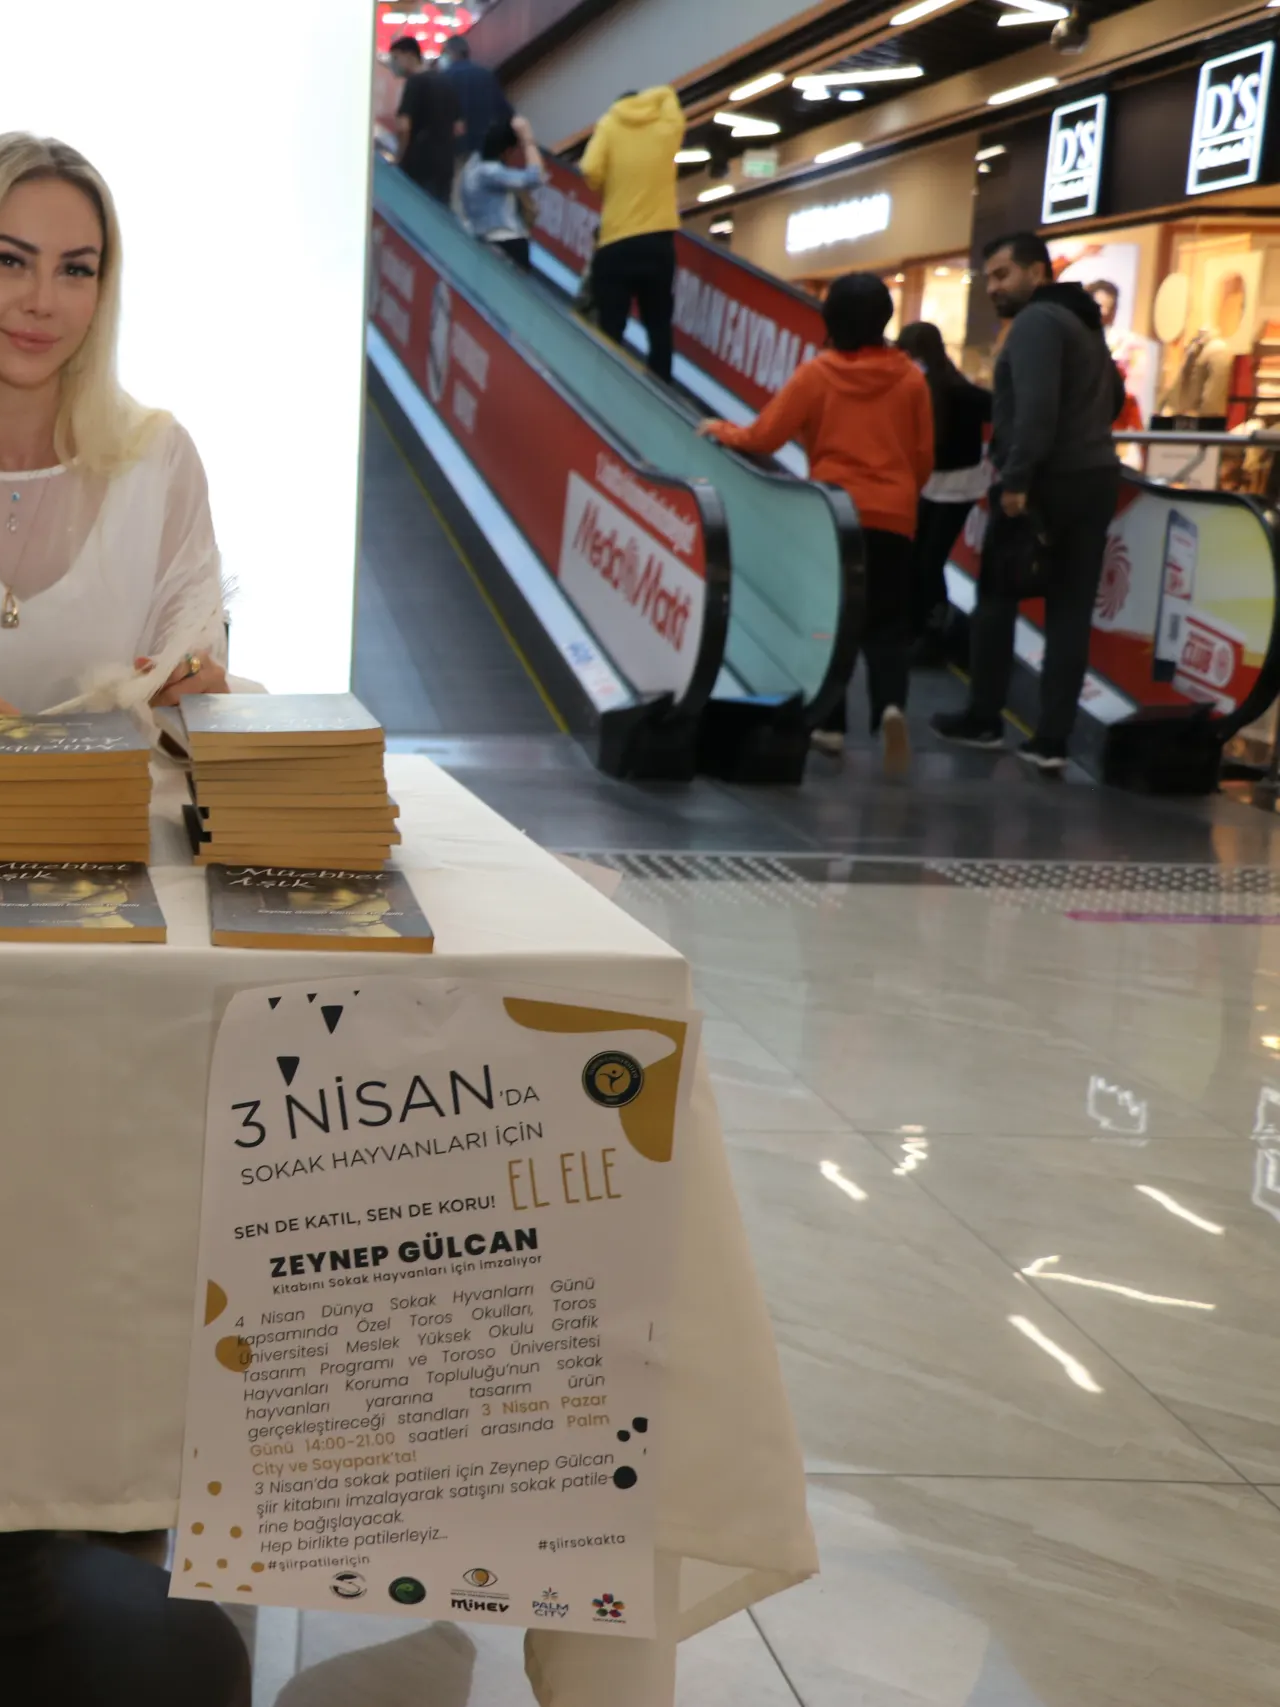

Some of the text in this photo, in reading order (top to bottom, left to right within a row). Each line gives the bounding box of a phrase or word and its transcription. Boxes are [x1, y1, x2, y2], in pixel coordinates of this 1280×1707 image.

[231, 1100, 266, 1148] 3
[241, 1122, 544, 1185] SOKAK HAYVANLARI İÇİN
[508, 1148, 623, 1211] EL ELE
[234, 1196, 495, 1239] SEN DE KATIL, SEN DE KORU!
[270, 1228, 538, 1278] ZEYNEP GÜLCAN
[273, 1254, 542, 1295] Kitabını Sokak Hayvanları için imzalıyor
[235, 1316, 244, 1327] 4
[261, 1309, 305, 1325] Nisan
[322, 1302, 373, 1319] Dünya
[390, 1294, 436, 1311] Sokak
[551, 1277, 595, 1293] Günü
[237, 1298, 596, 1348] kapsamında Özel Toros Okulları, Toros
[346, 1336, 399, 1353] Meslek
[418, 1328, 471, 1346] Yüksek
[489, 1323, 534, 1338] Okulu
[552, 1316, 599, 1331] Grafik
[243, 1335, 600, 1382] Tasarım Programı ve Toroso Üniversitesi
[244, 1383, 328, 1403] Hayvanları
[346, 1374, 409, 1391] Koruma
[557, 1355, 603, 1370] sokak
[246, 1374, 605, 1422] hayvanları yararına tasarım ürün
[248, 1394, 607, 1442] gerçekleştireceği standları 3 Nisan Pazar
[250, 1441, 294, 1457] Günü
[408, 1425, 468, 1444] saatleri
[481, 1418, 554, 1436] arasında
[567, 1413, 610, 1428] Palm
[252, 1450, 417, 1478] City ve Sayapark'ta!
[255, 1452, 614, 1495] 3 Nisan'da sokak patileri için Zeynep Gülcan
[257, 1501, 276, 1519] şiir
[283, 1496, 340, 1513] kitabını
[345, 1485, 444, 1508] imzalayarak
[450, 1483, 504, 1500] satışını
[510, 1477, 556, 1493] sokak
[259, 1510, 404, 1534] rine bağışlayacak.
[261, 1540, 292, 1555] Hep
[298, 1533, 348, 1551] birlikte
[532, 1600, 569, 1612] PALM
[534, 1608, 567, 1619] CITY
